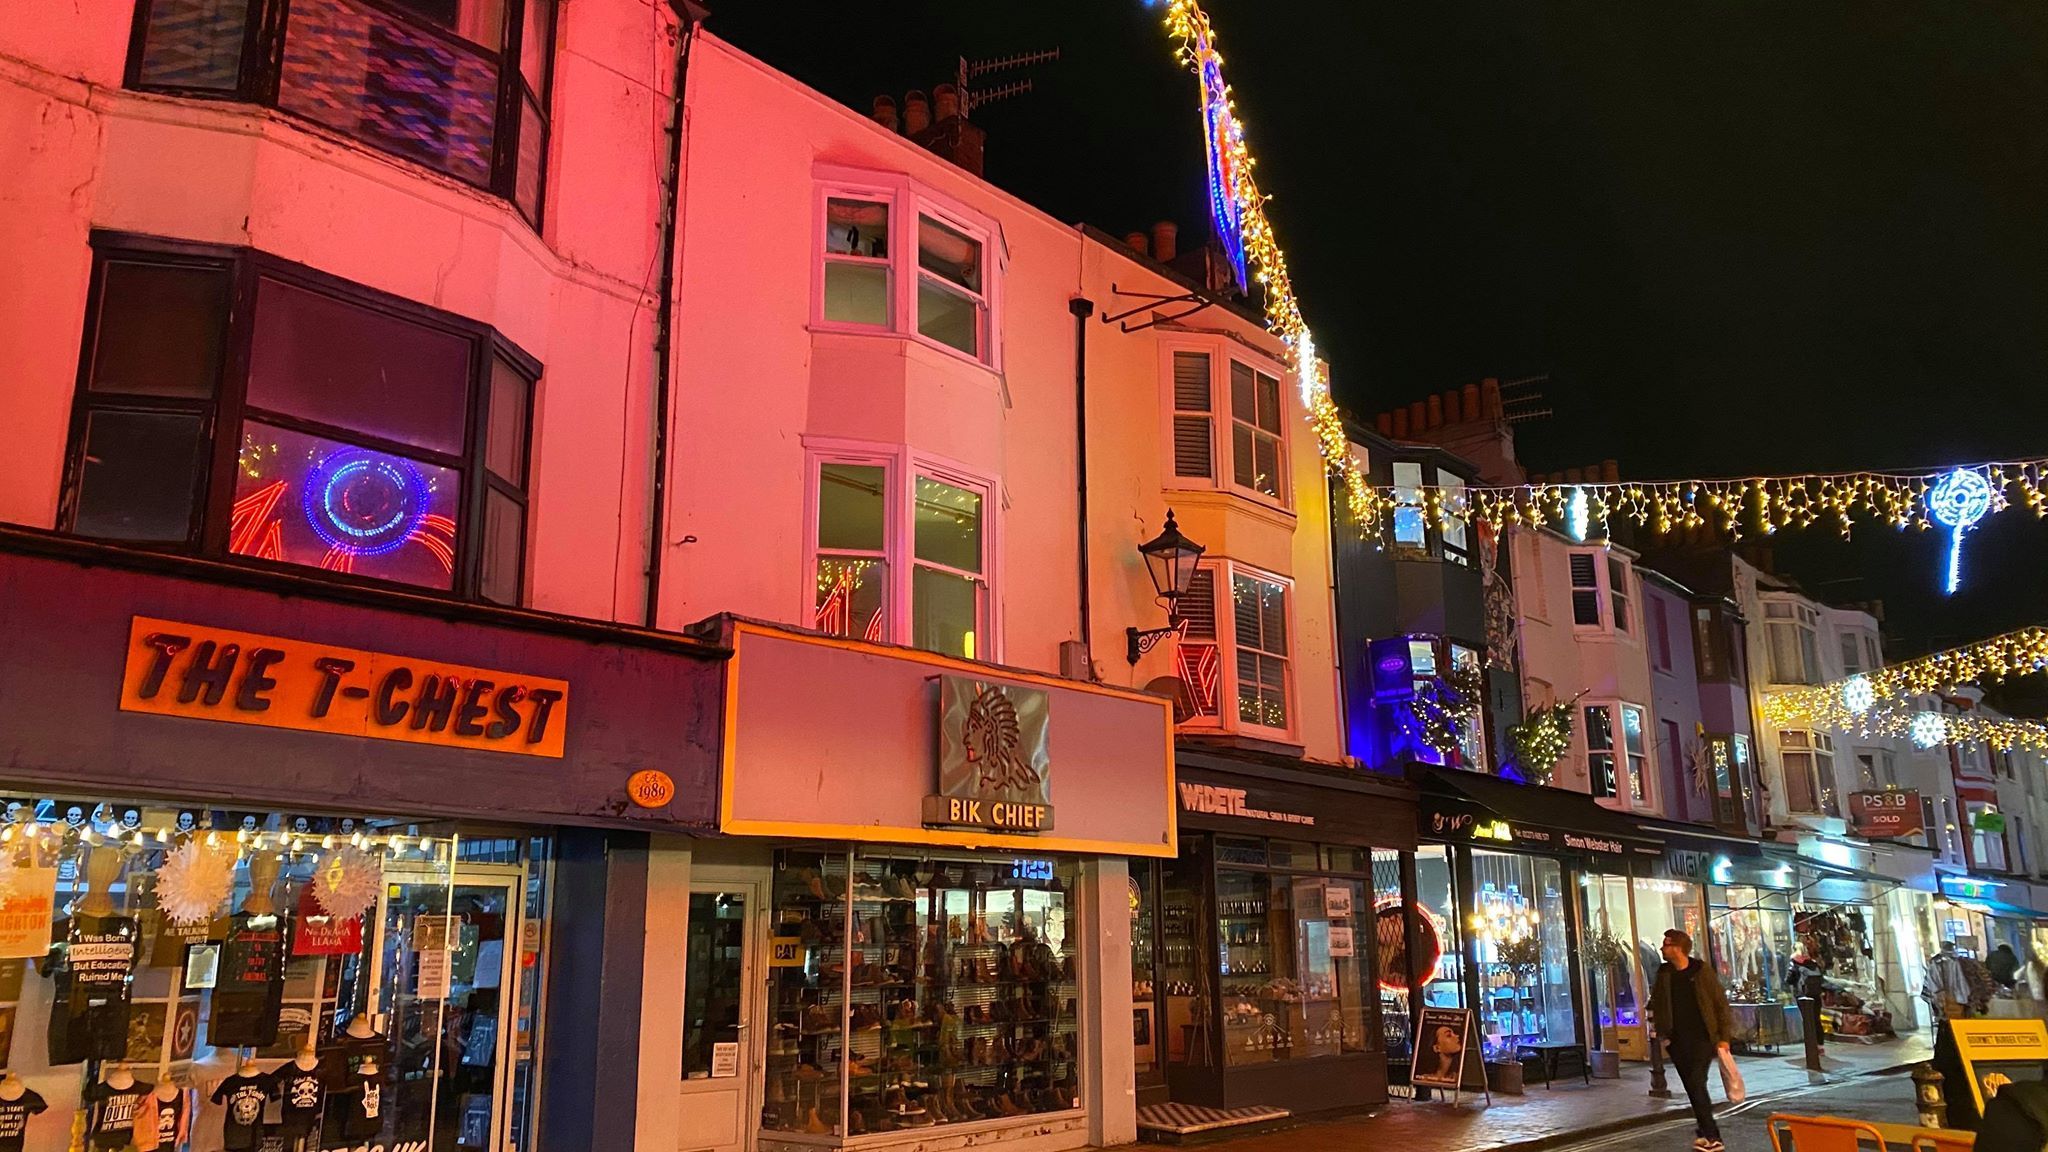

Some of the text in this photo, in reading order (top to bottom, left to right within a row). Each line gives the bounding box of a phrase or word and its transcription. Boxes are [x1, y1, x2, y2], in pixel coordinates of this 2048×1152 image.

[138, 633, 563, 744] THE T-CHEST
[639, 783, 666, 801] 1989
[1862, 794, 1907, 807] PS&B
[950, 798, 1046, 828] BIK CHIEF
[1872, 815, 1901, 823] SOLD
[1563, 833, 1586, 849] Simon
[1584, 837, 1610, 852] Webster
[1609, 840, 1623, 854] Hair
[84, 934, 104, 943] Was
[105, 934, 126, 942] Born
[312, 936, 343, 947] LLAMA
[72, 944, 131, 958] Intelligent
[774, 943, 798, 960] CAT
[73, 961, 129, 971] But Educatio
[78, 972, 124, 982] Ruined Me
